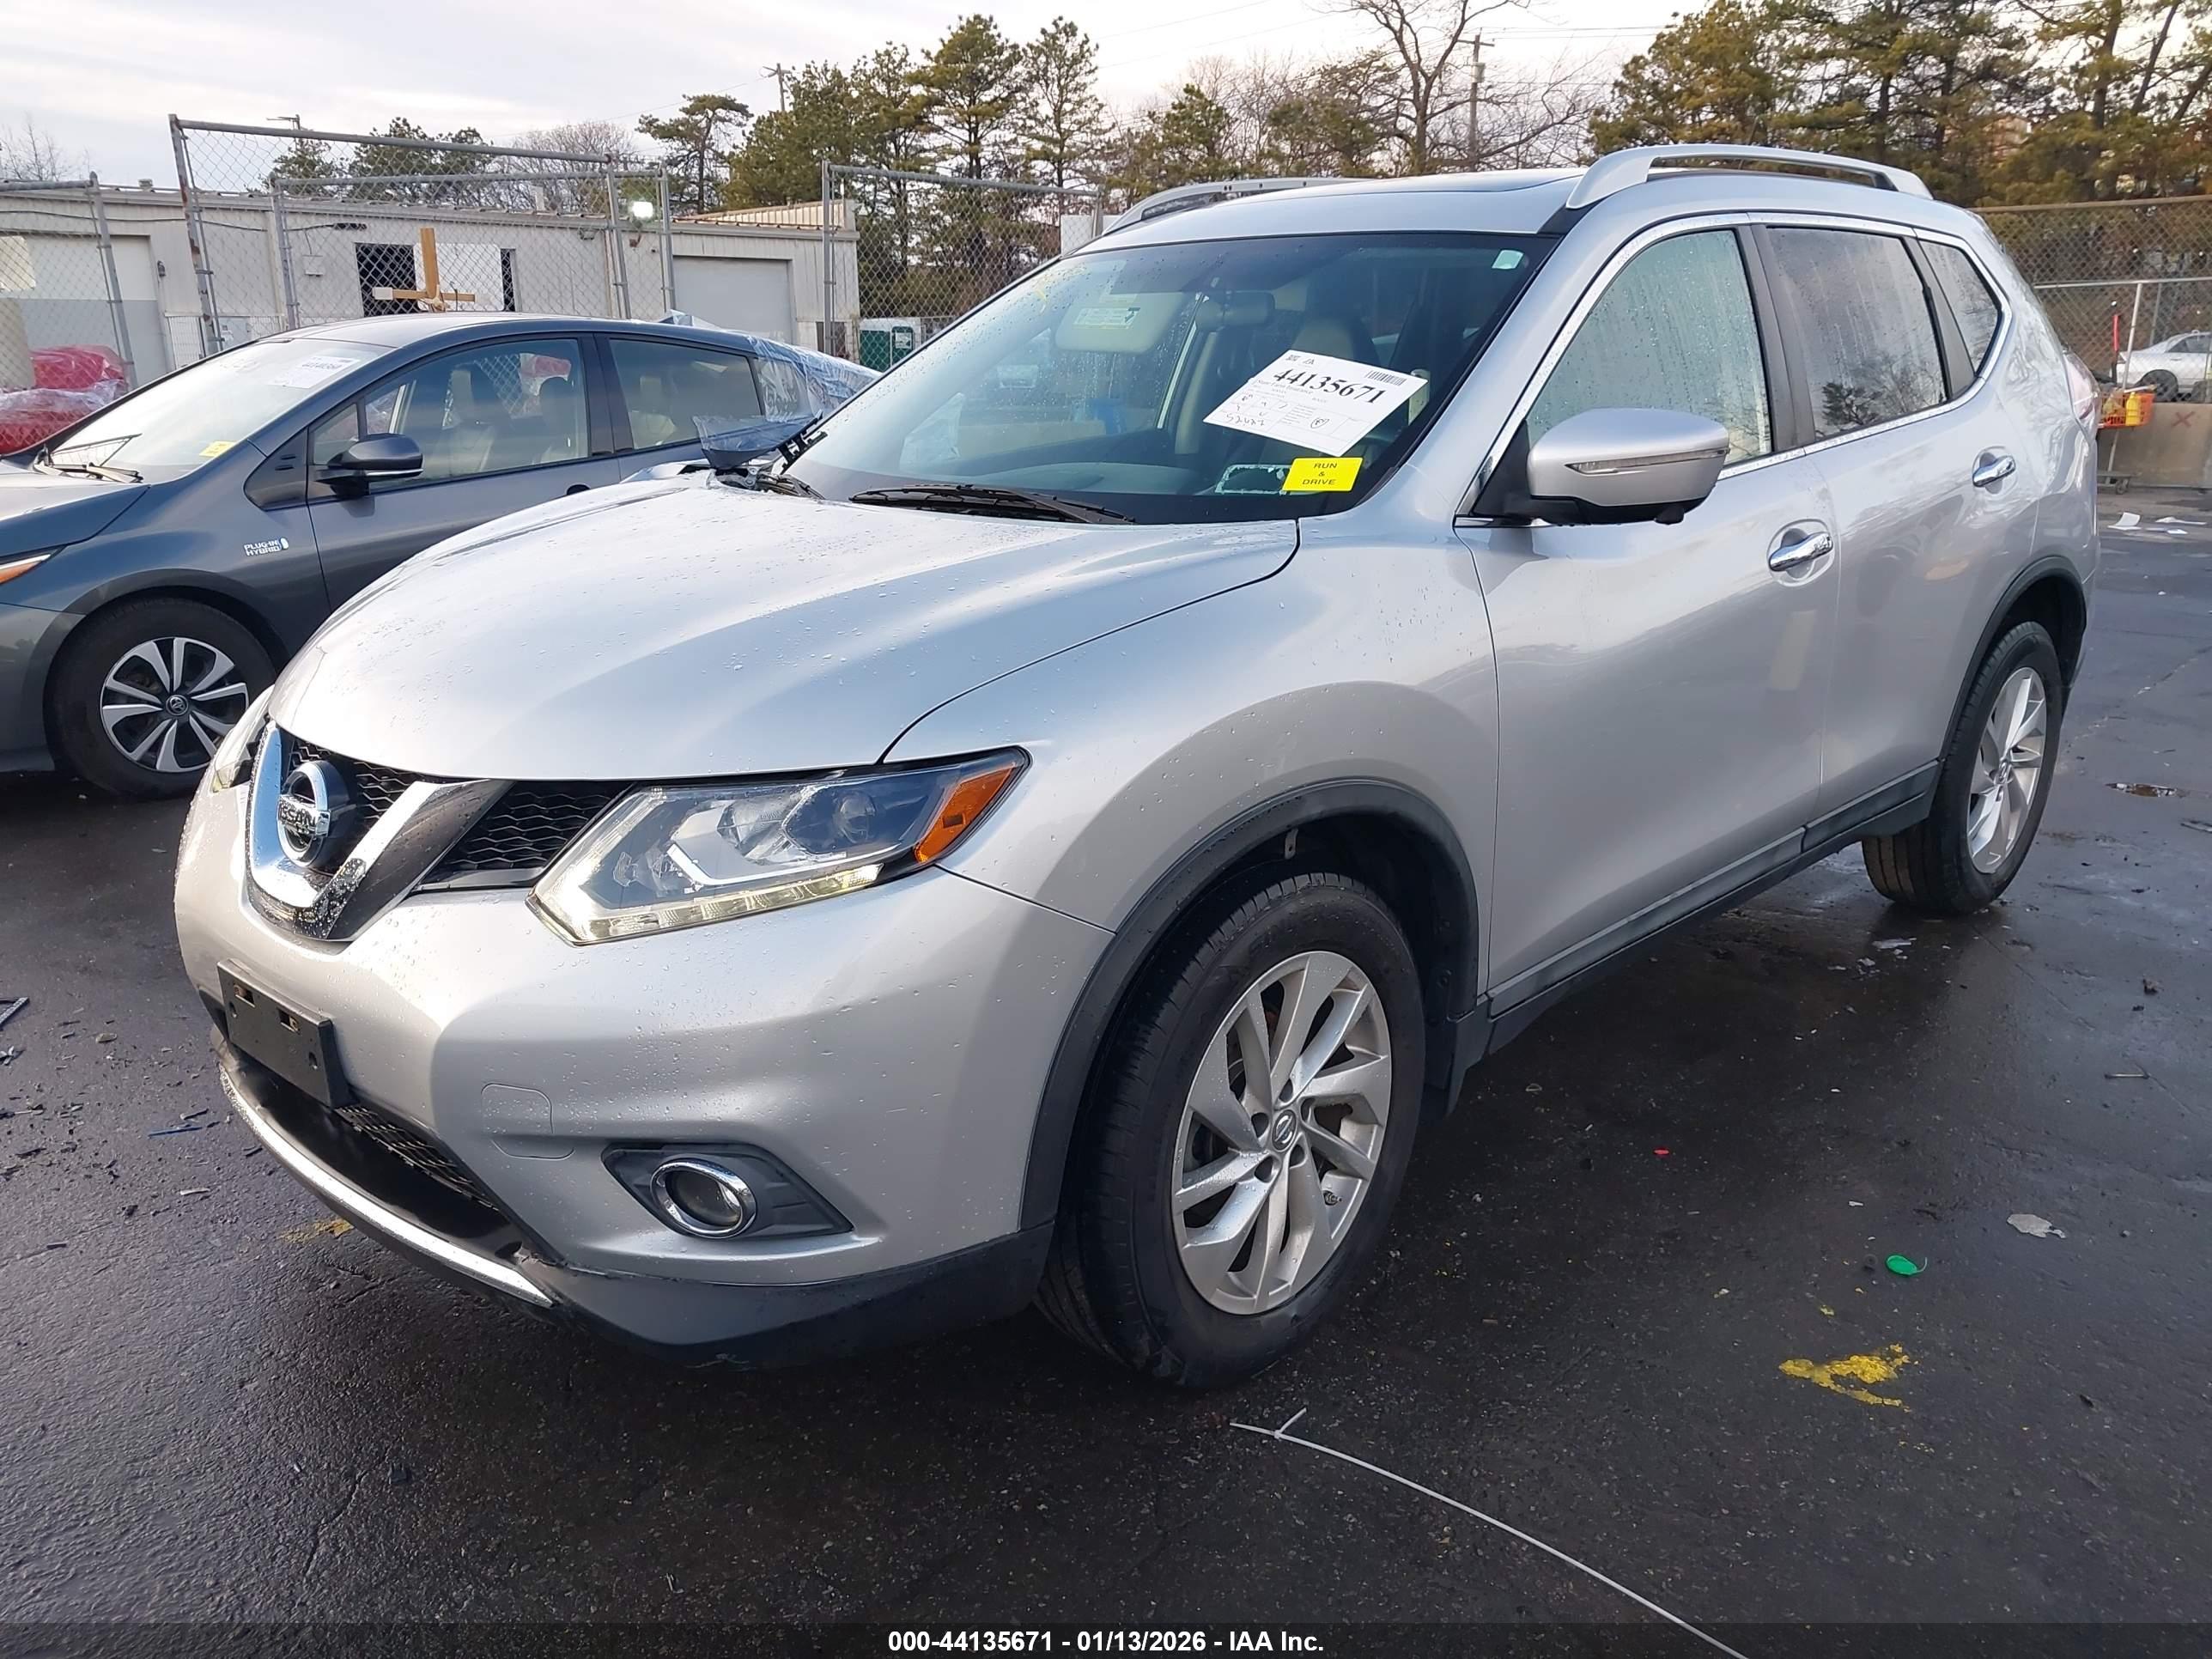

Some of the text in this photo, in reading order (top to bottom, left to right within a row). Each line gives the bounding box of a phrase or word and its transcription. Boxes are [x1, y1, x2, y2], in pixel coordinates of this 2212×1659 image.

[1273, 369, 1387, 404] 44135671
[243, 540, 278, 550] PLUG-IN
[246, 545, 280, 556] HYBRID
